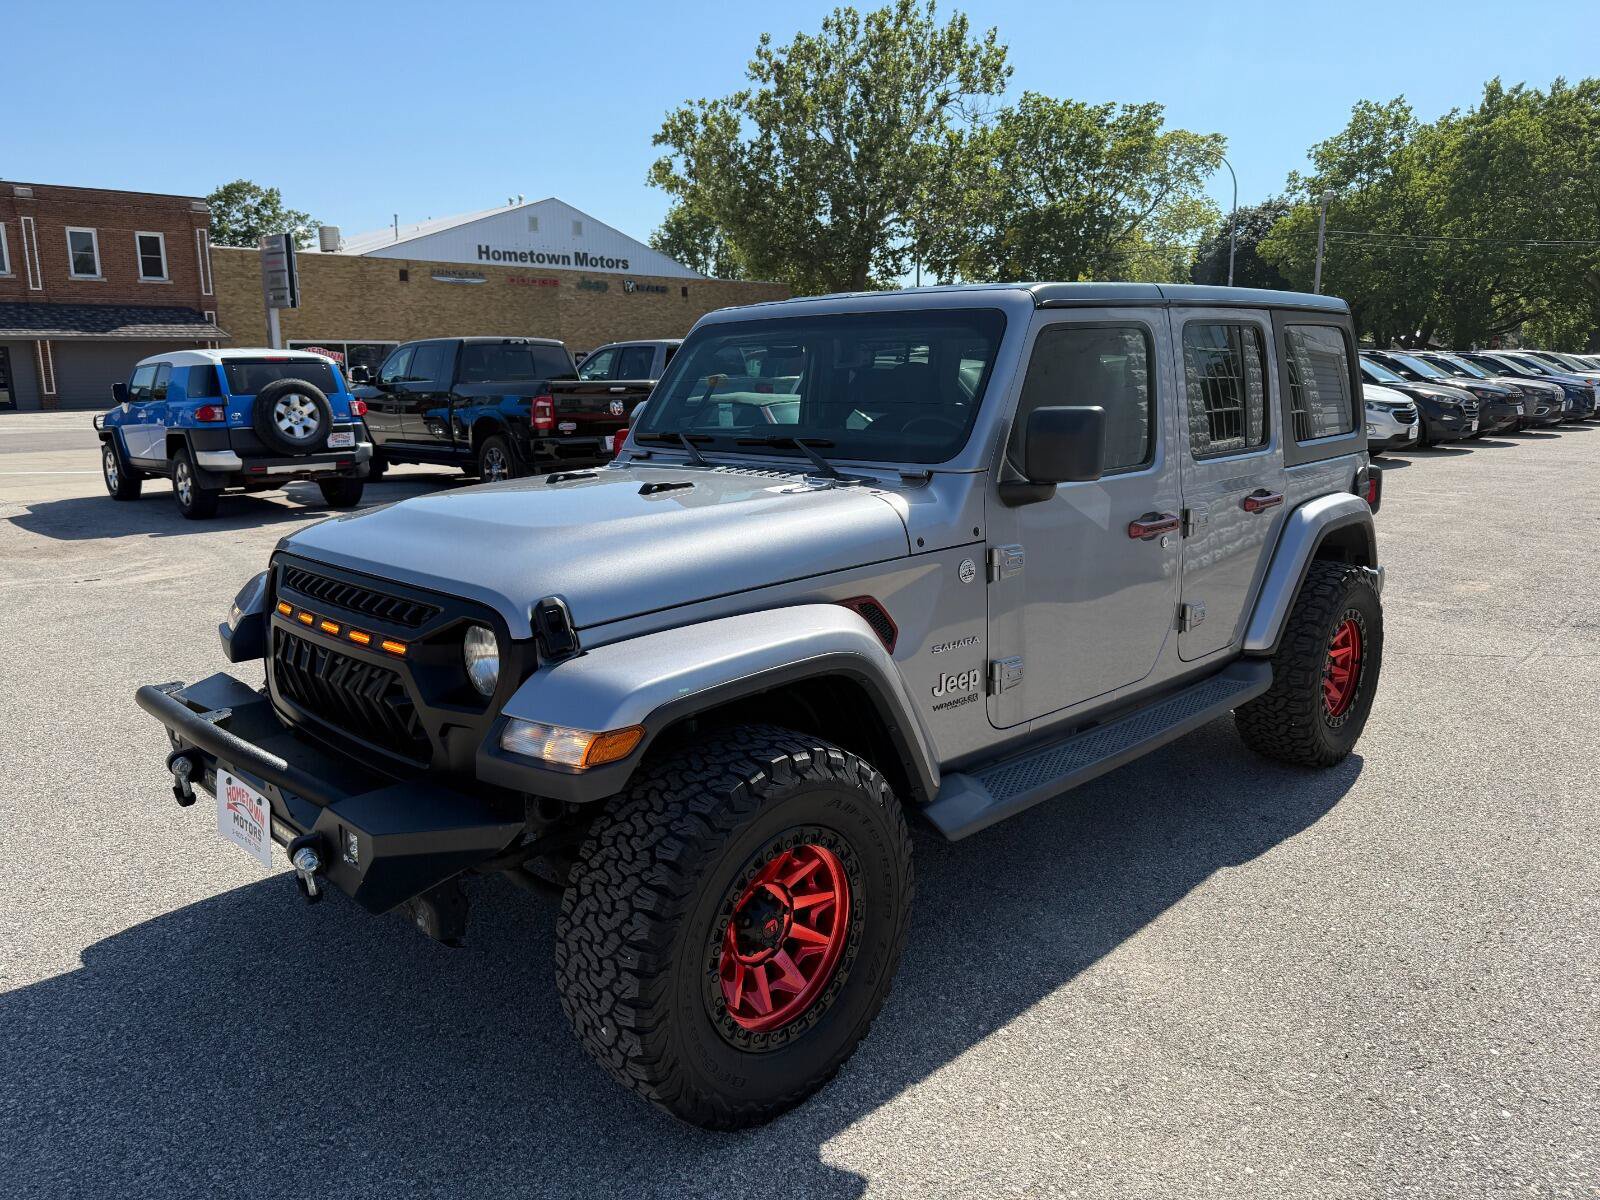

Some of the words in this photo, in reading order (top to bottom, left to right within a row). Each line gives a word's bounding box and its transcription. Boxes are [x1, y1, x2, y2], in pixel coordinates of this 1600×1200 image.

[477, 244, 571, 266] Hometown
[574, 251, 629, 270] Motors
[932, 636, 981, 654] SAHARA
[932, 668, 981, 697] Jeep
[932, 693, 979, 712] WRANGLER
[226, 786, 265, 828] HOMETOWN
[233, 812, 262, 842] MOTORS
